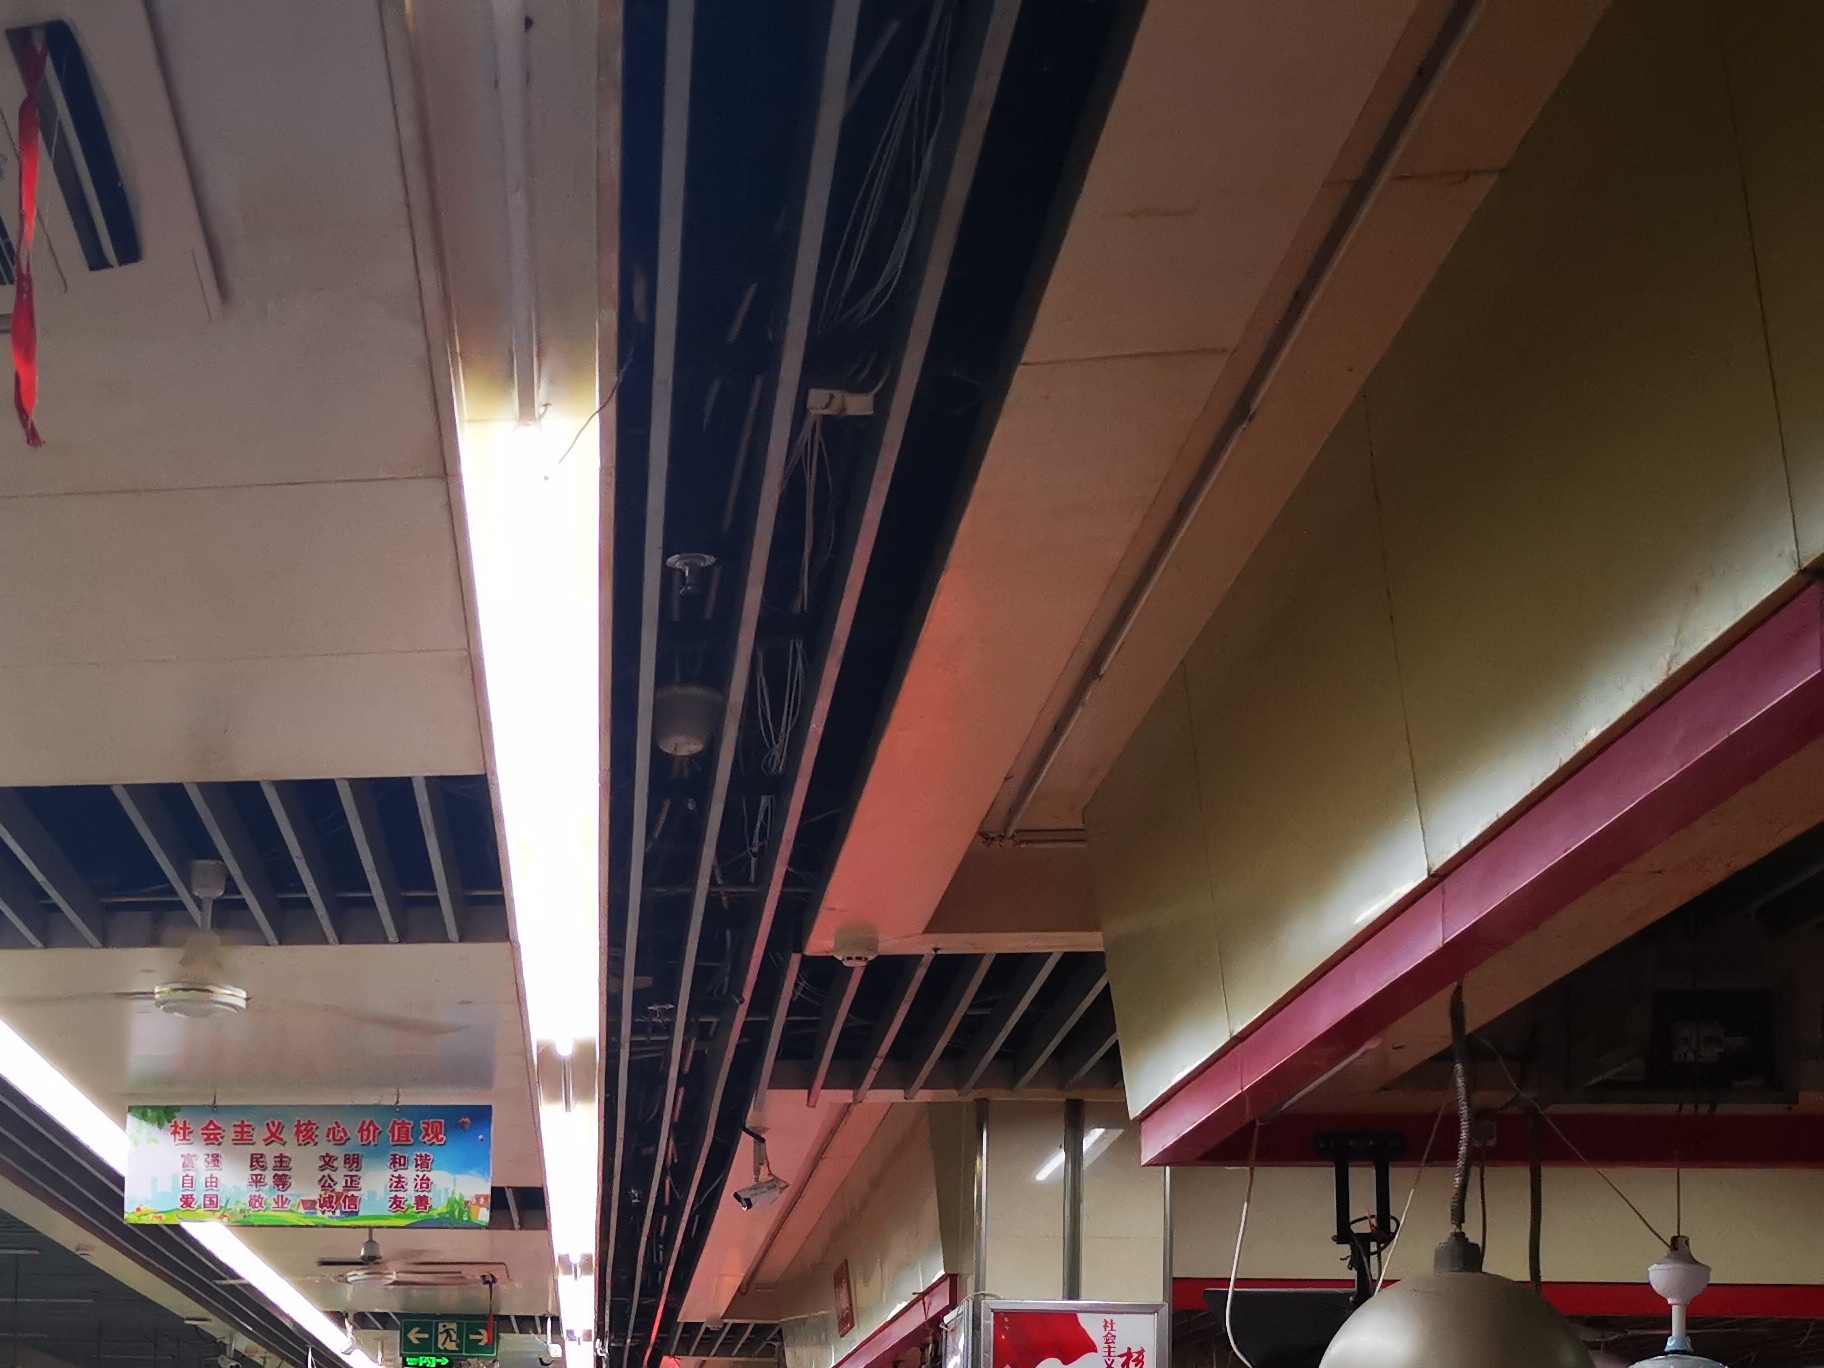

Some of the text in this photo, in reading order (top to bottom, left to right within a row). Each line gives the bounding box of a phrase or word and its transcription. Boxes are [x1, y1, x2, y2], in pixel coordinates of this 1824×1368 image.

[170, 1119, 447, 1147] 社会主义核心价值观
[180, 1152, 434, 1171] 富强 民主 文明 和谐
[180, 1174, 433, 1191] 自由 平等 公正 法治
[179, 1193, 433, 1212] 爱国 敬业 诚信 友善
